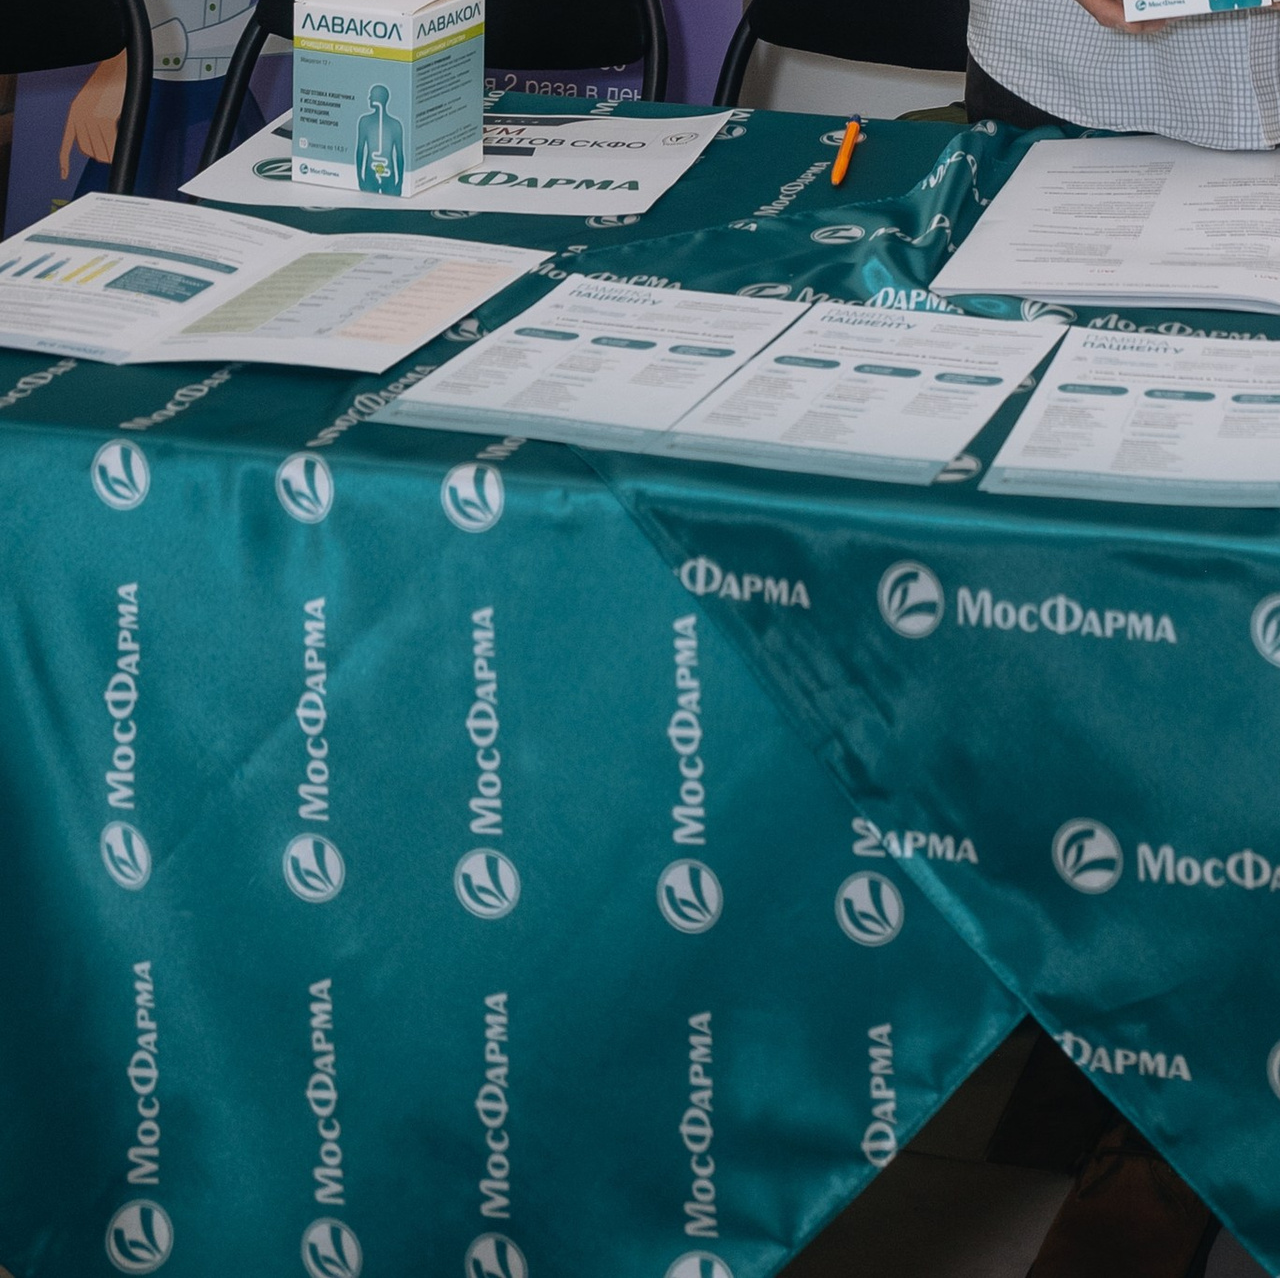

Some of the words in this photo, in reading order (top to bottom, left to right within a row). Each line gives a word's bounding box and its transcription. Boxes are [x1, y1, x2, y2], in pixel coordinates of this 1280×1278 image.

[301, 12, 402, 42] ЛАВАКОЛ
[416, 2, 481, 40] ЛАВАКОЛ
[570, 139, 647, 150] СКФО
